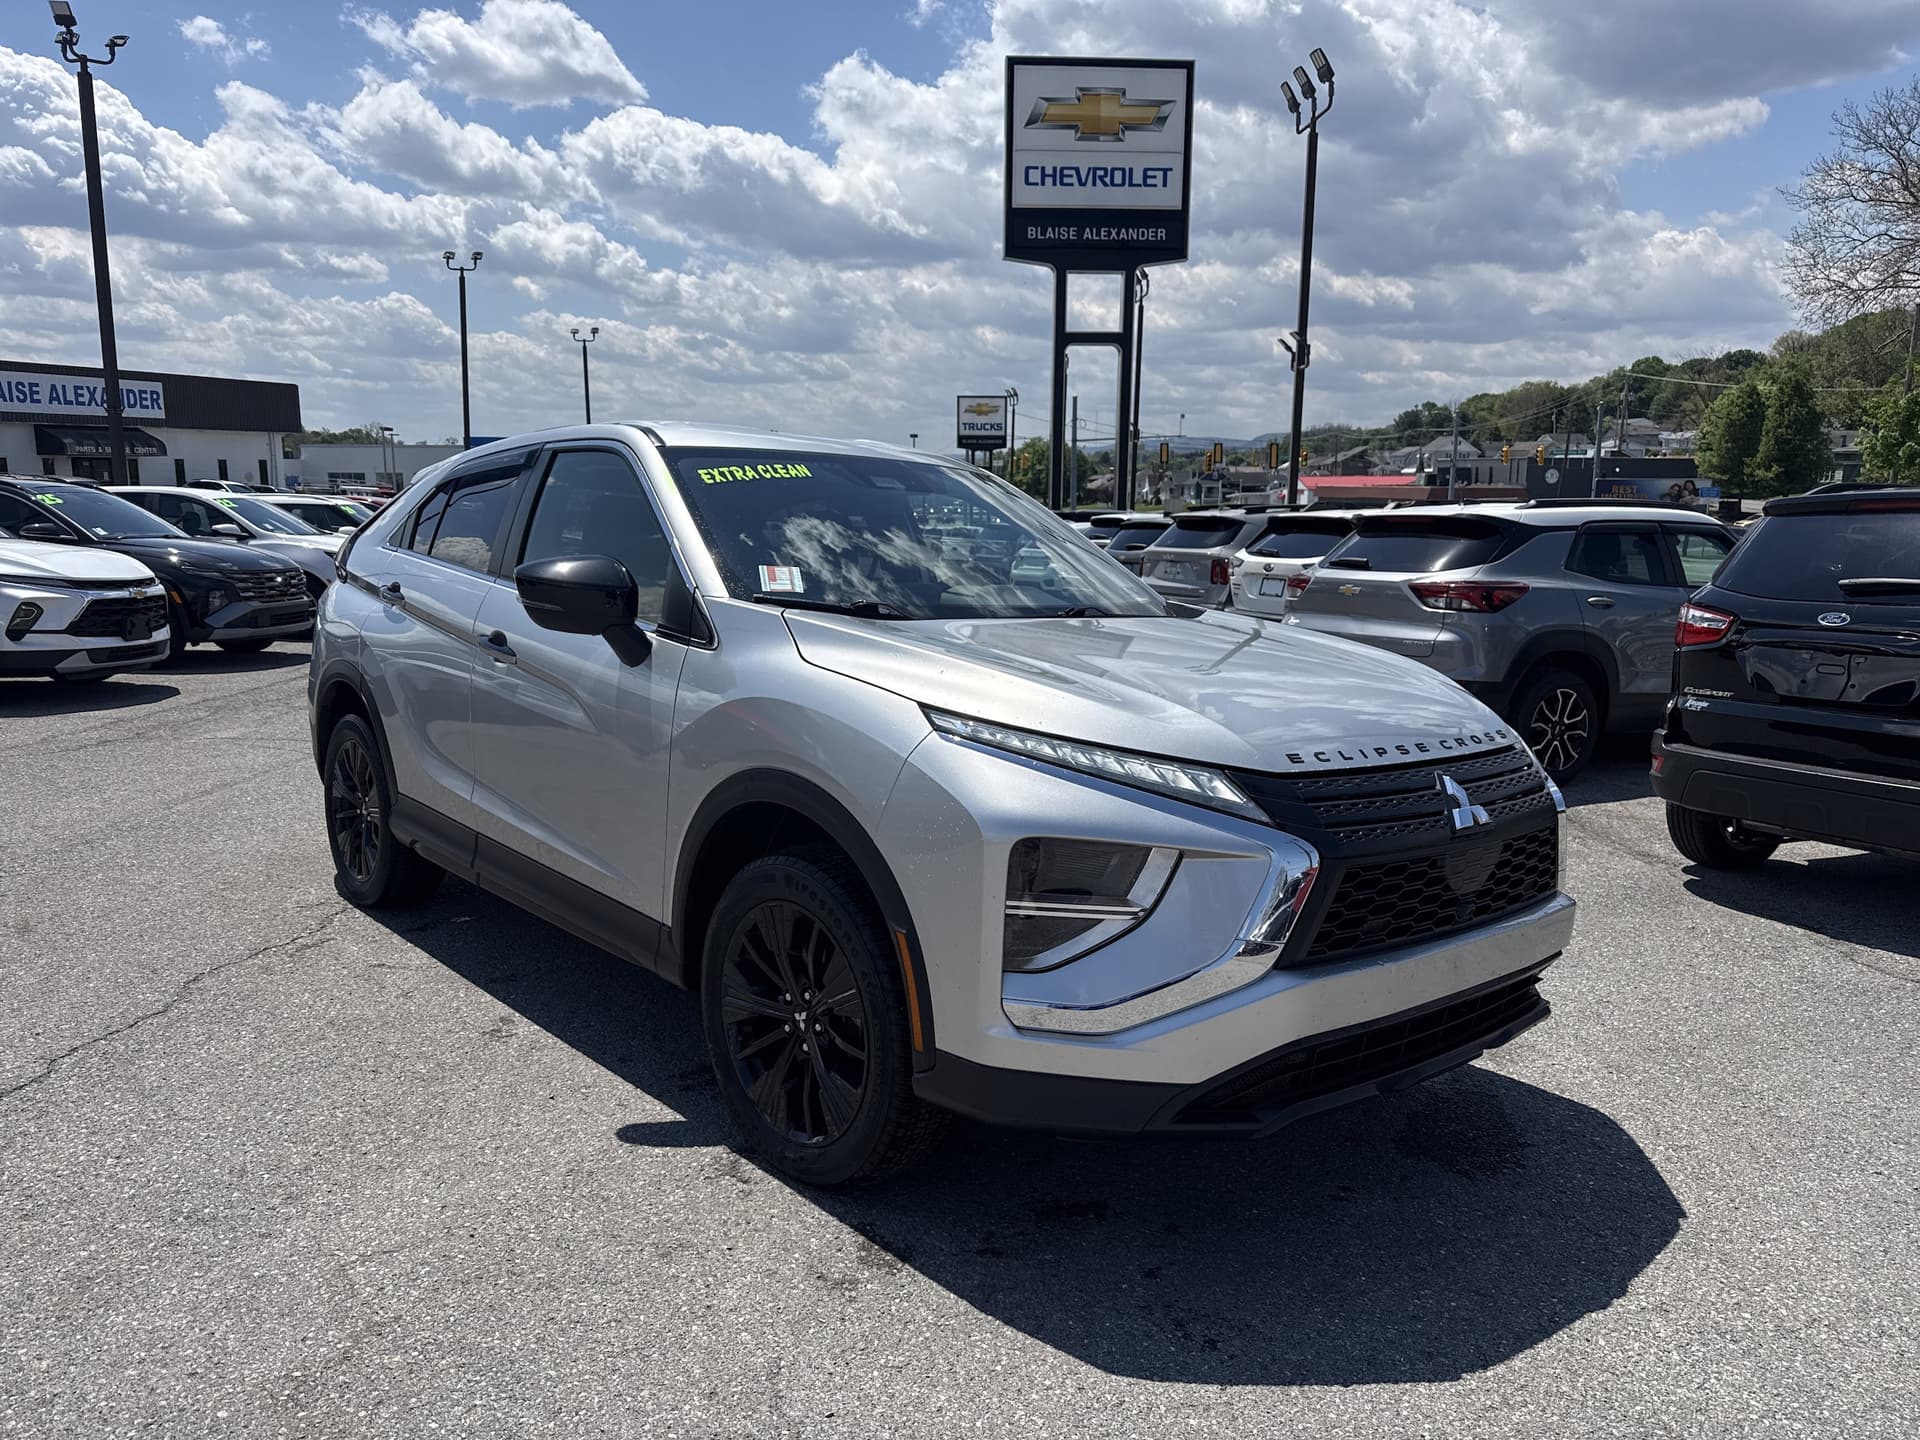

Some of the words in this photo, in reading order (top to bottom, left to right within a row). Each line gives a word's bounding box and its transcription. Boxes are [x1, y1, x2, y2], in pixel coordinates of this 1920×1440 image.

[1024, 166, 1173, 188] CHEVROLET
[1027, 226, 1077, 240] BLAISE
[1083, 228, 1166, 241] ALEXANDER
[962, 422, 1003, 431] TRUCKS
[697, 465, 760, 484] EXTRA
[757, 464, 812, 479] CLEAN
[1286, 742, 1431, 764] ECLIPSE
[1439, 729, 1507, 750] CROSS
